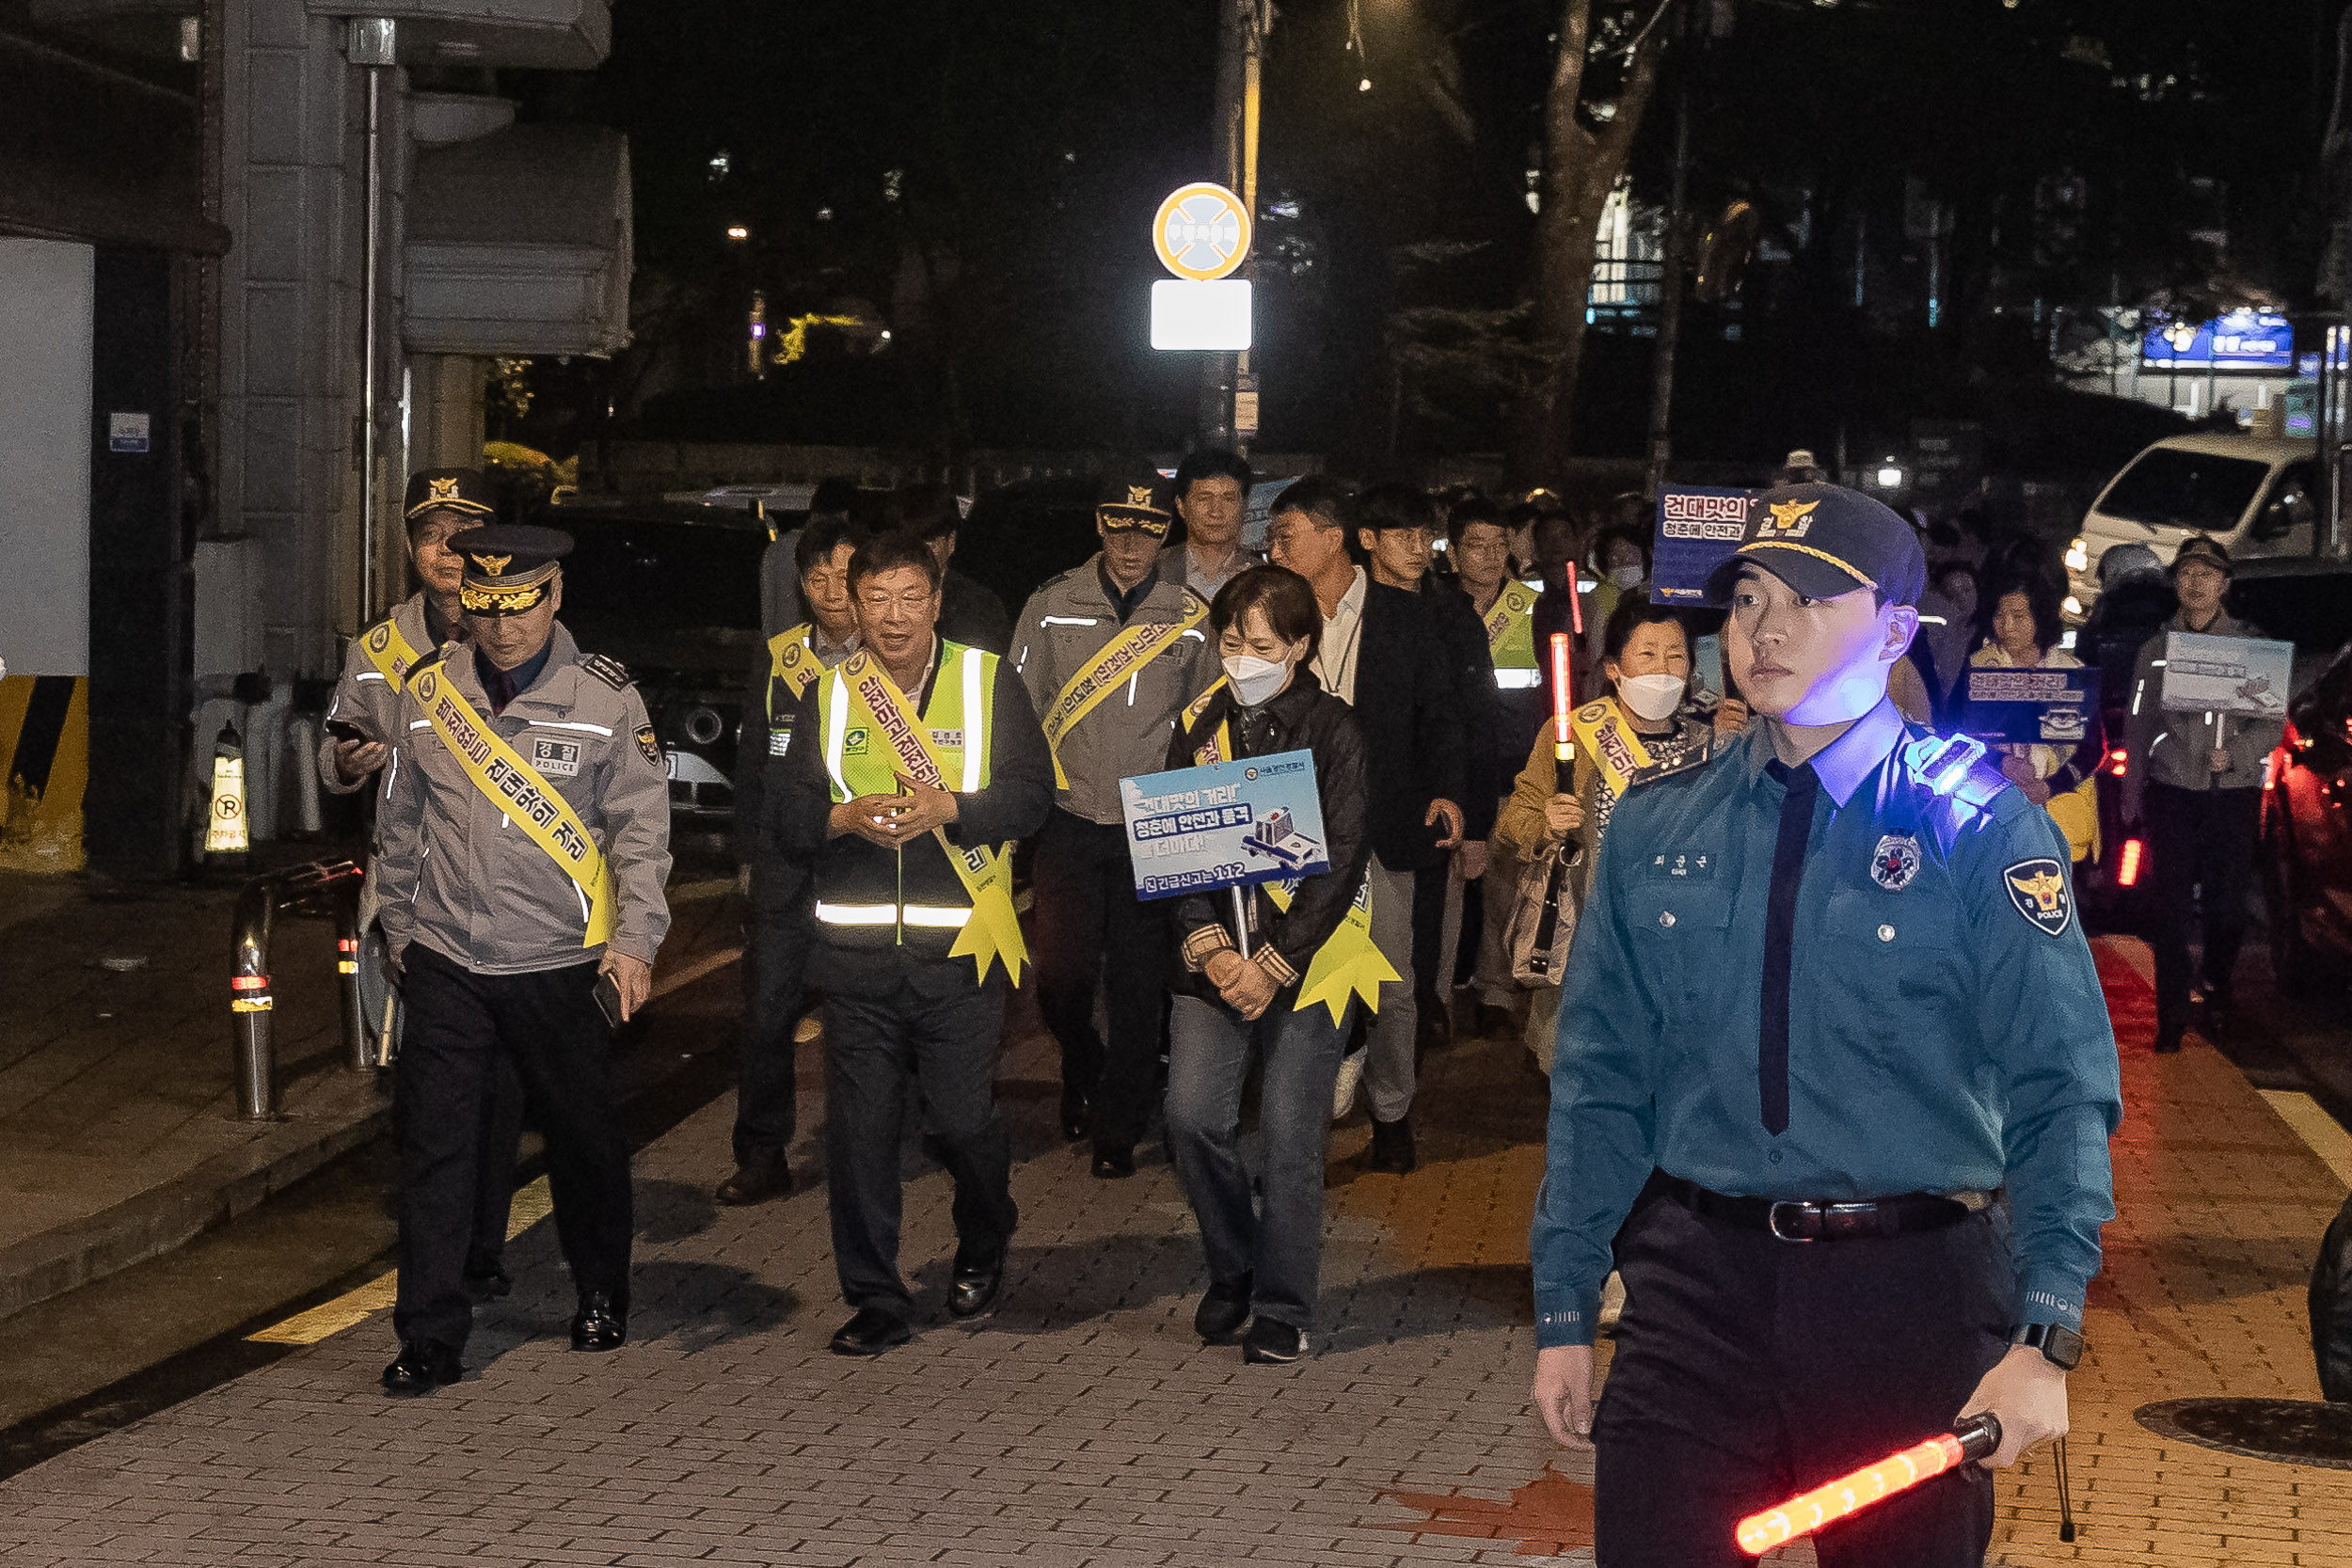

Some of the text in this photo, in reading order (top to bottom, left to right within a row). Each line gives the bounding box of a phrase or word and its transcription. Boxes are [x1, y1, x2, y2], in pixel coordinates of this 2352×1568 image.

[1665, 494, 1747, 522] 건대맛의
[858, 674, 909, 745] 안전하고
[535, 761, 574, 772] POLICE
[485, 756, 559, 829] 건대맛의
[552, 819, 588, 862] 거리
[1136, 806, 1249, 839] 청춘에 안전과 품격
[1157, 863, 1246, 890] 긴급신고는 112
[2037, 909, 2064, 921] POLICE
